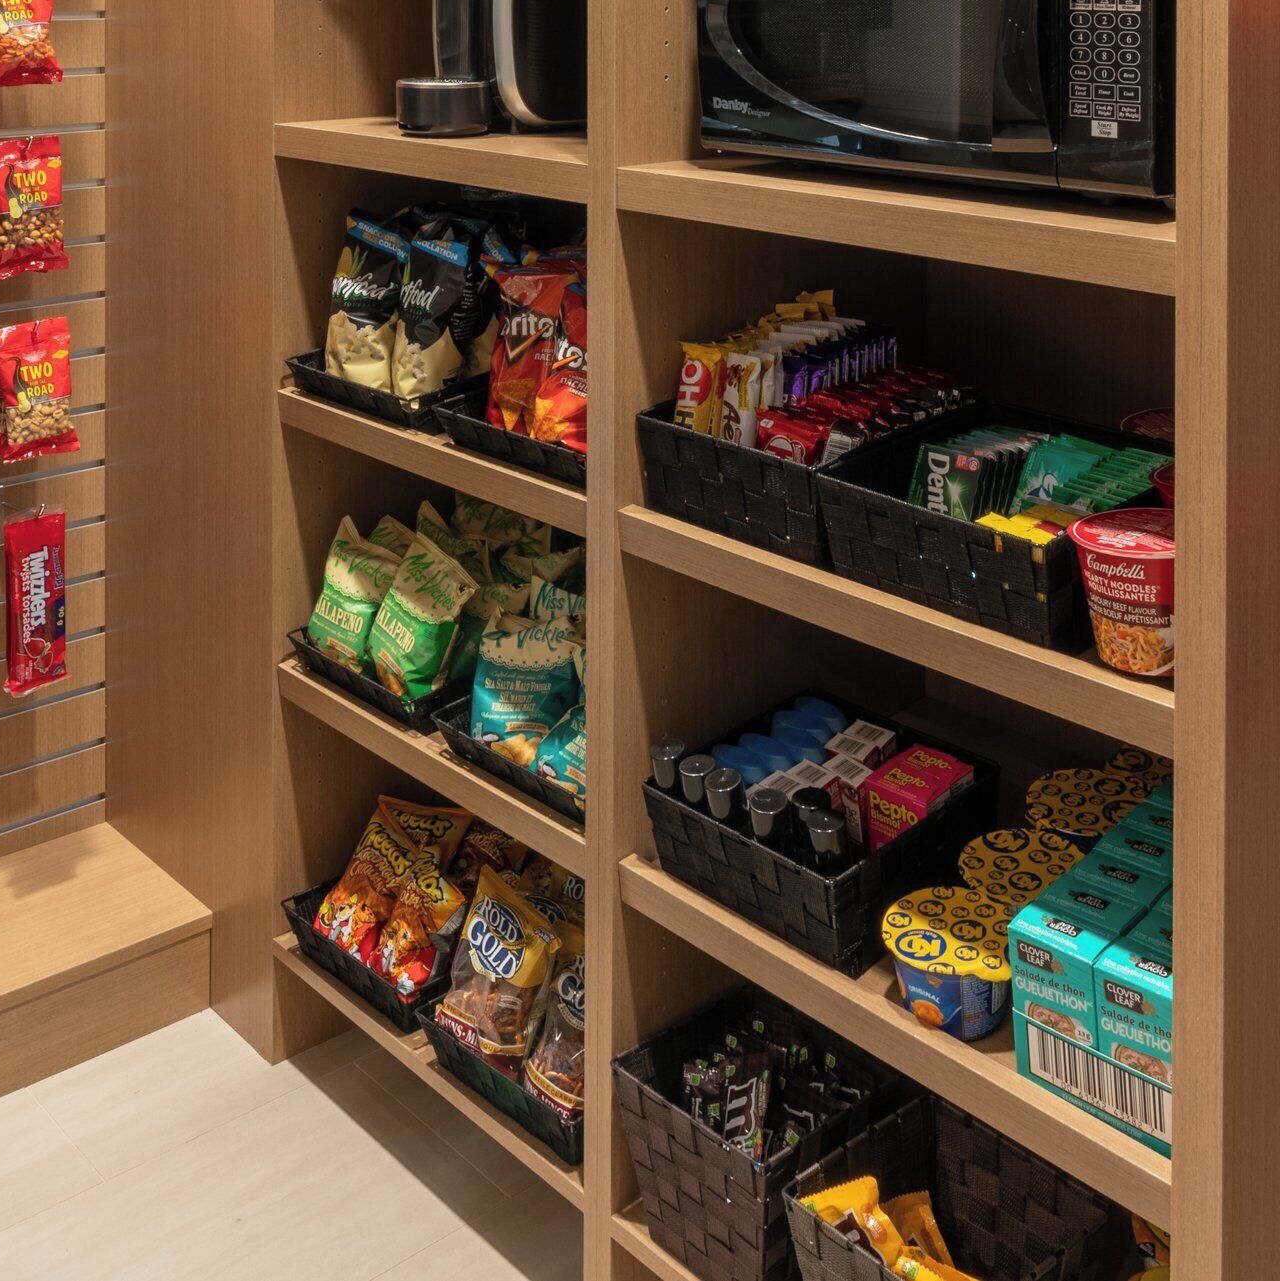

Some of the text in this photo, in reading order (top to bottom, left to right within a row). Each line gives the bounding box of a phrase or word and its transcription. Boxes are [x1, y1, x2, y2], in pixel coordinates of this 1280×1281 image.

[4, 9, 34, 22] ROAD
[712, 96, 748, 114] Danby
[13, 170, 47, 188] TWO
[19, 191, 48, 204] ROAD
[20, 361, 53, 382] TWO
[26, 382, 55, 399] ROAD
[1086, 553, 1147, 580] Campbell's
[29, 545, 51, 628] Twizzlers
[1110, 581, 1157, 594] NOODLES
[1112, 601, 1157, 616] BEEF FLAVOUR
[869, 790, 919, 826] Pepto
[480, 894, 518, 945] ROLD
[467, 916, 521, 980] GOLD
[1019, 943, 1051, 962] CLOVER
[1026, 953, 1046, 968] LEAF
[1015, 966, 1086, 999] Salade de thon
[1015, 975, 1087, 1013] GUEULETHON
[1106, 983, 1141, 1002] CLOVER
[1115, 994, 1135, 1009] LEAF
[1100, 1006, 1151, 1031] Salade de
